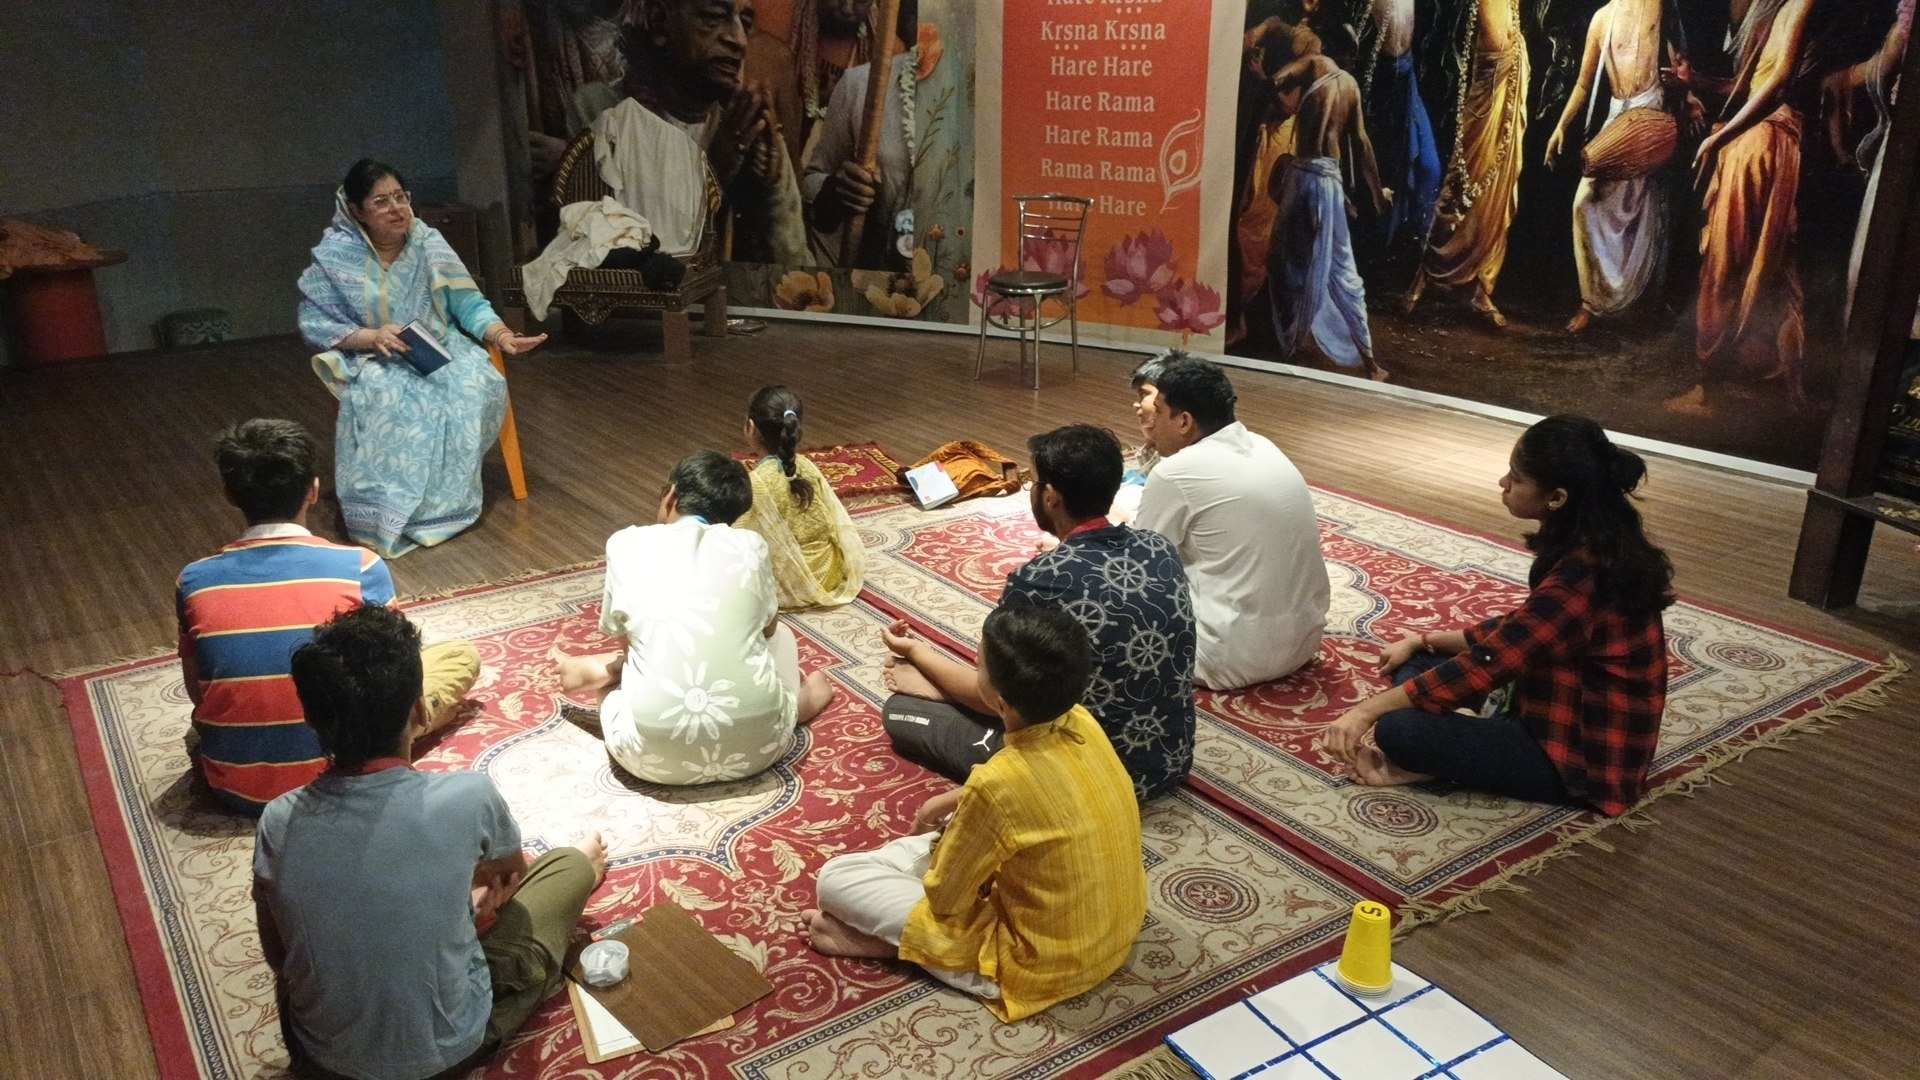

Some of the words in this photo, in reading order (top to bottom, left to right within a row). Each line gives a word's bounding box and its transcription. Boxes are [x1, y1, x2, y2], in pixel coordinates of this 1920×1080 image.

[1051, 56, 1097, 76] Hare
[1103, 56, 1153, 77] Hare
[1045, 90, 1092, 111] Hare
[1097, 91, 1155, 112] Rama
[1045, 125, 1091, 145] Hare
[1096, 126, 1153, 148] Rama
[1041, 158, 1094, 179] Rama
[1100, 161, 1156, 182] Rama
[1100, 195, 1147, 216] Hare
